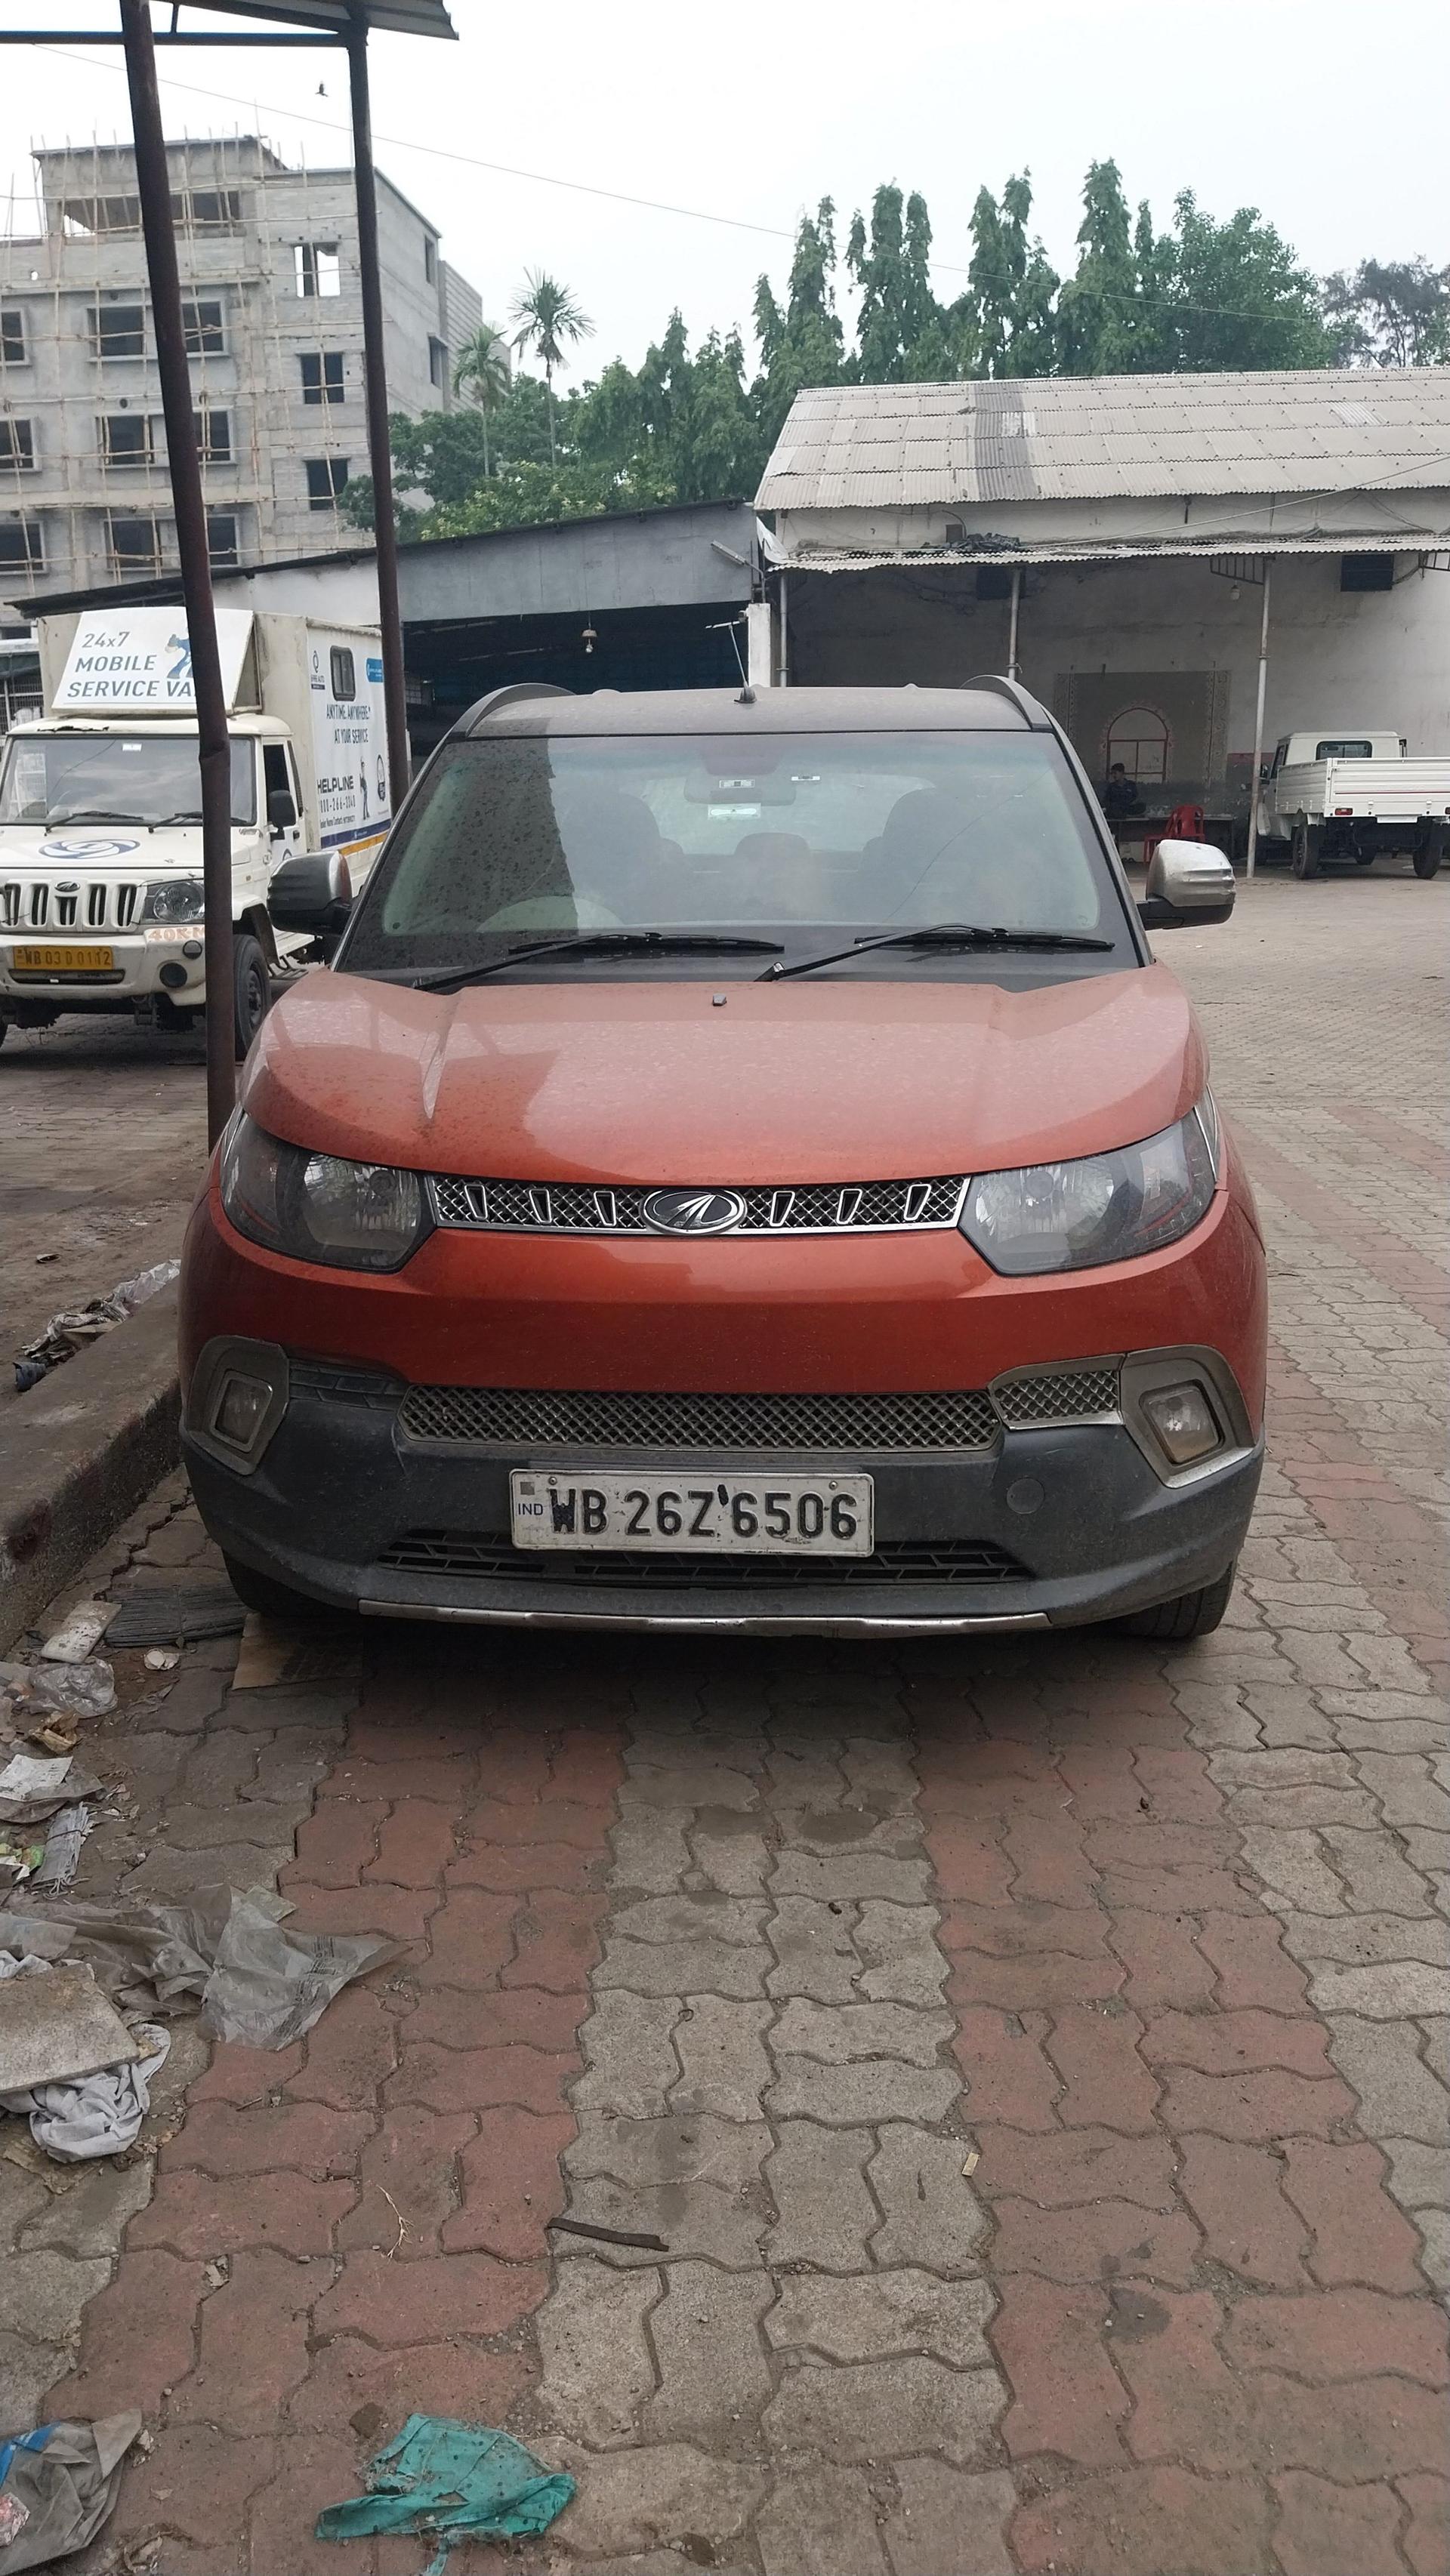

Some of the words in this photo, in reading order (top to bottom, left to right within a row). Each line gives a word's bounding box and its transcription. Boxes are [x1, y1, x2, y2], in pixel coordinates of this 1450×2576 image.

[82, 631, 130, 649] 24x7
[75, 655, 157, 673] MOBILE
[67, 680, 159, 698] SERVICE
[166, 680, 196, 697] VA
[335, 728, 340, 744] AT
[341, 728, 351, 744] YOUR
[352, 728, 369, 744] SERVICE
[316, 775, 354, 794] HELPLINE
[25, 950, 42, 965] WB
[45, 951, 60, 965] 03
[518, 1503, 544, 1516] IND
[549, 1488, 607, 1535] WB
[732, 1491, 857, 1540] 6506
